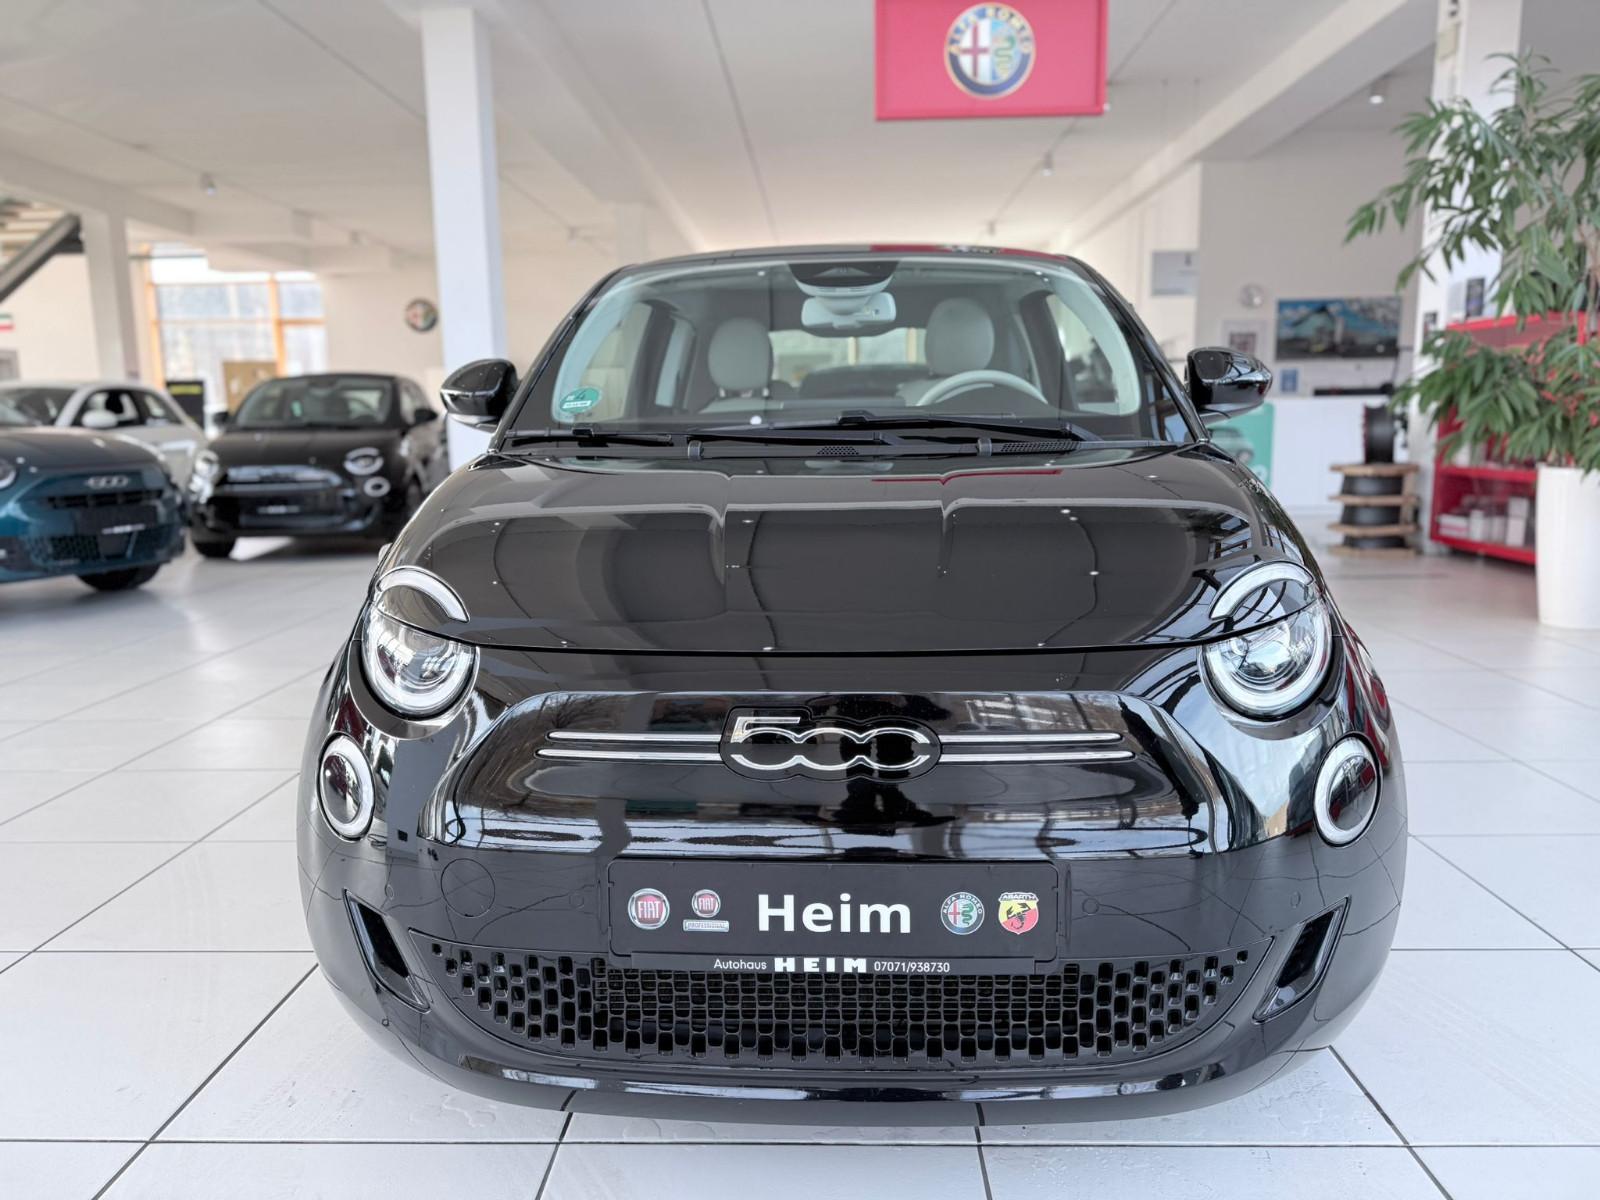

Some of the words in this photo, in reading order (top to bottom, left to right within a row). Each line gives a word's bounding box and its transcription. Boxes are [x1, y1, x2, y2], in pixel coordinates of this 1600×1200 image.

[730, 716, 931, 771] 500
[637, 900, 661, 919] FIAT
[698, 897, 716, 911] FIAT
[758, 893, 911, 934] Heim
[713, 958, 767, 971] Autohaus
[774, 957, 867, 973] HEIM
[873, 961, 951, 973] 07071/938730
